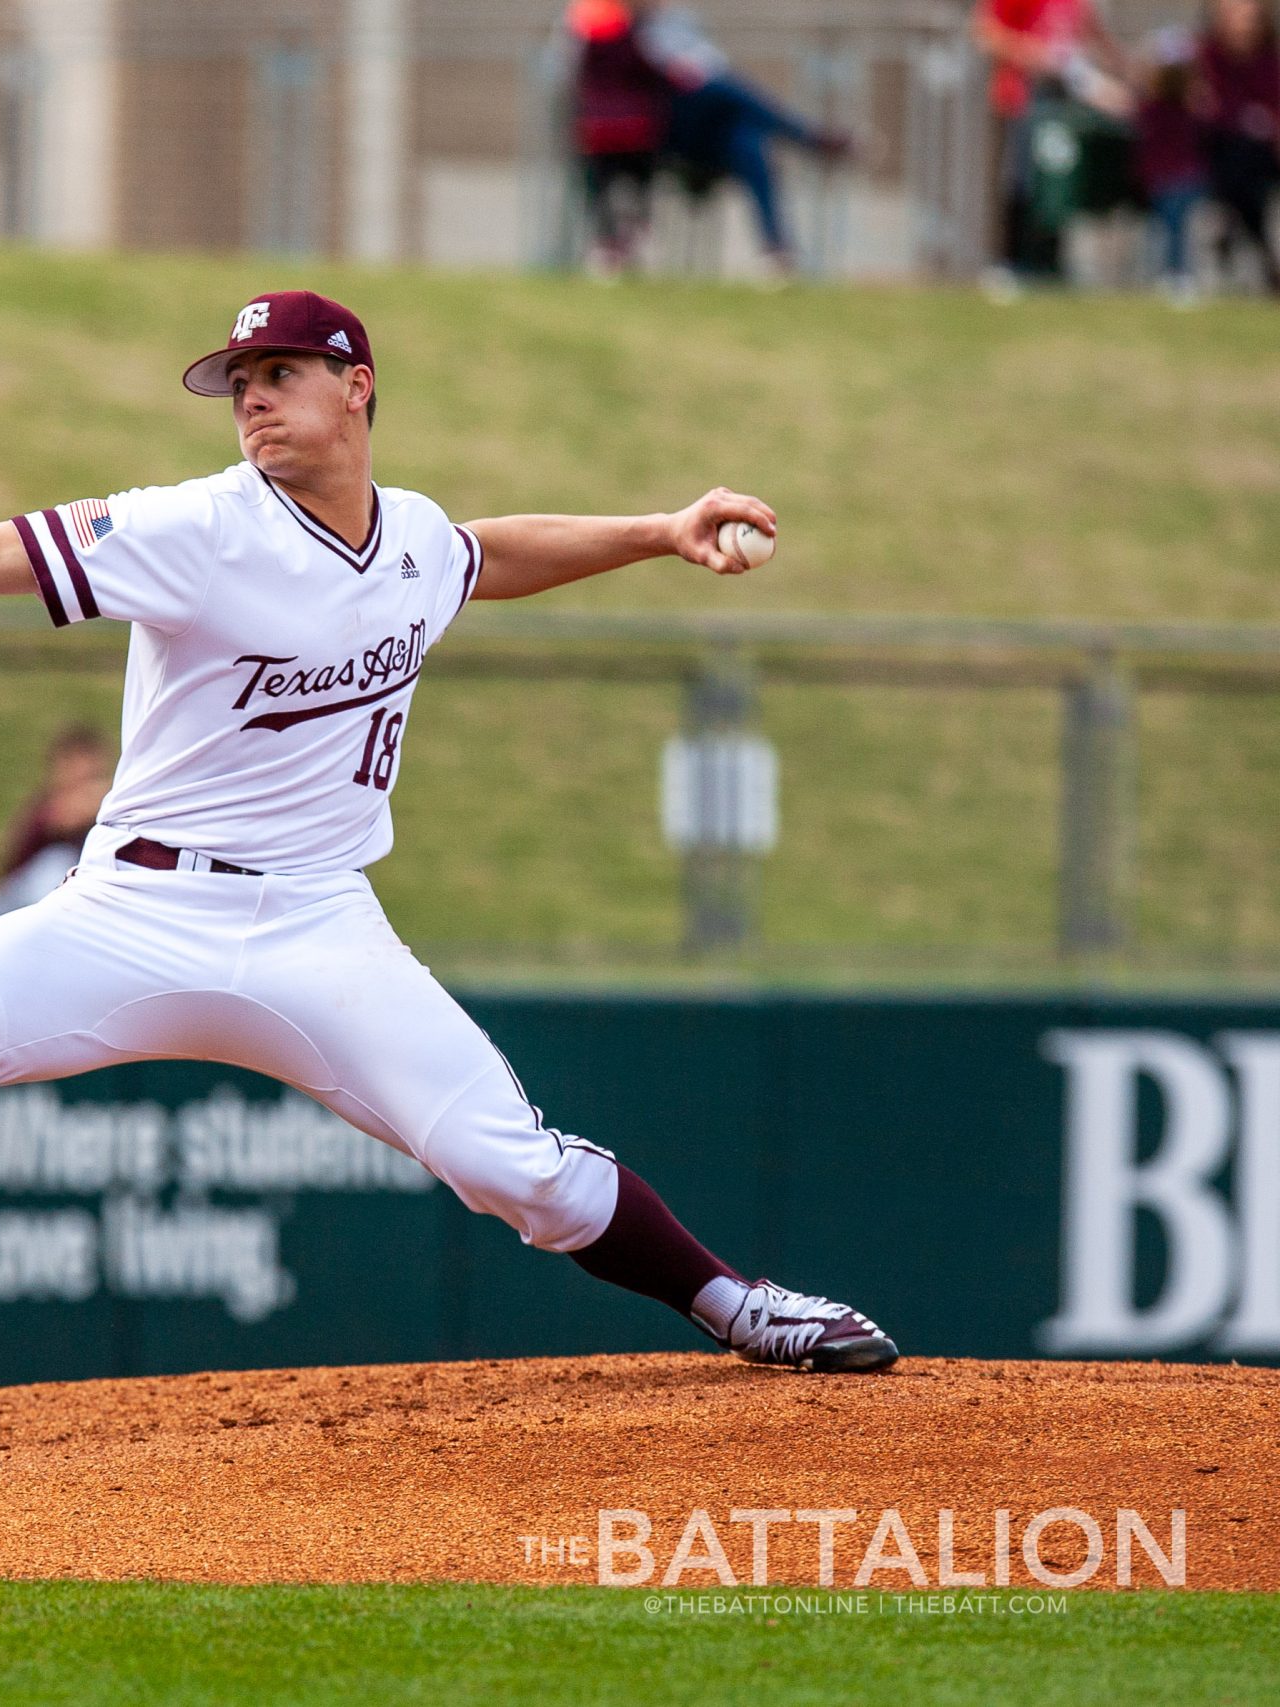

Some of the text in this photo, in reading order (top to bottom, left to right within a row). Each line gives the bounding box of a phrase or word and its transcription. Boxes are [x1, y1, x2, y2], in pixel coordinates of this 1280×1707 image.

[231, 618, 426, 710] Texas A&M
[352, 706, 403, 791] 18
